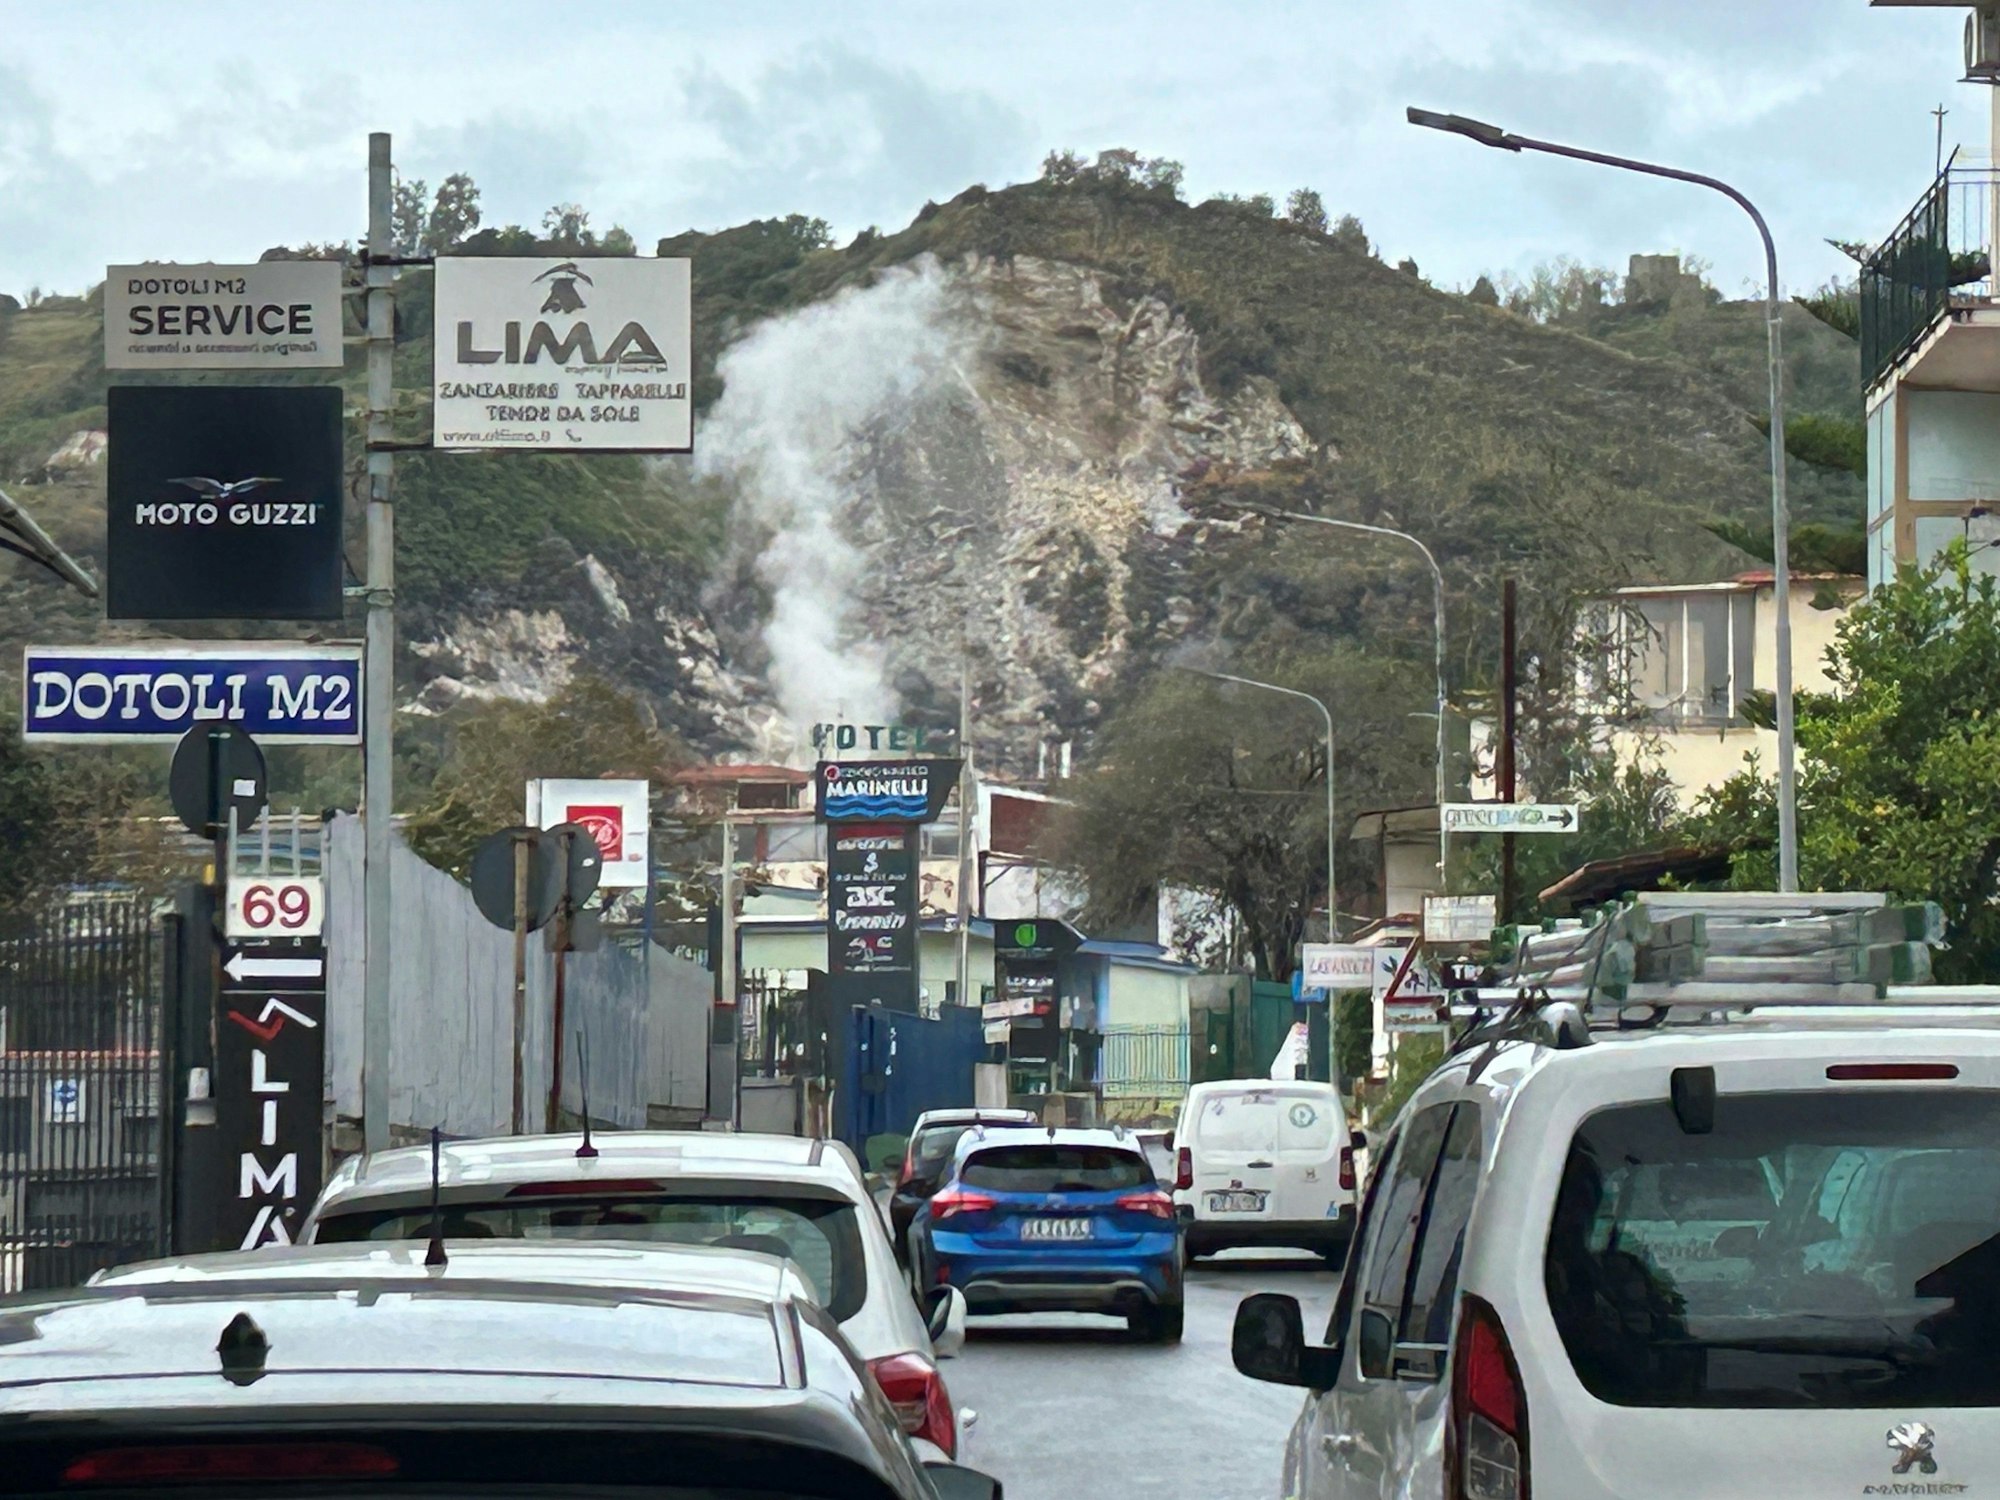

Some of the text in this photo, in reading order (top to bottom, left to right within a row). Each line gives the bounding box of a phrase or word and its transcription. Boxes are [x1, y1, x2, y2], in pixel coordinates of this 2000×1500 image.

[128, 279, 209, 295] DOTOLI
[128, 304, 313, 336] SERVICE
[457, 321, 667, 364] LIMA
[556, 406, 585, 422] DA
[591, 406, 640, 422] SOLE
[135, 503, 316, 525] MOTO GUZZI
[33, 671, 351, 721] DOTOLI M2
[826, 779, 928, 797] MARINELLI
[242, 885, 311, 928] 69
[238, 1049, 297, 1251] LIMA
